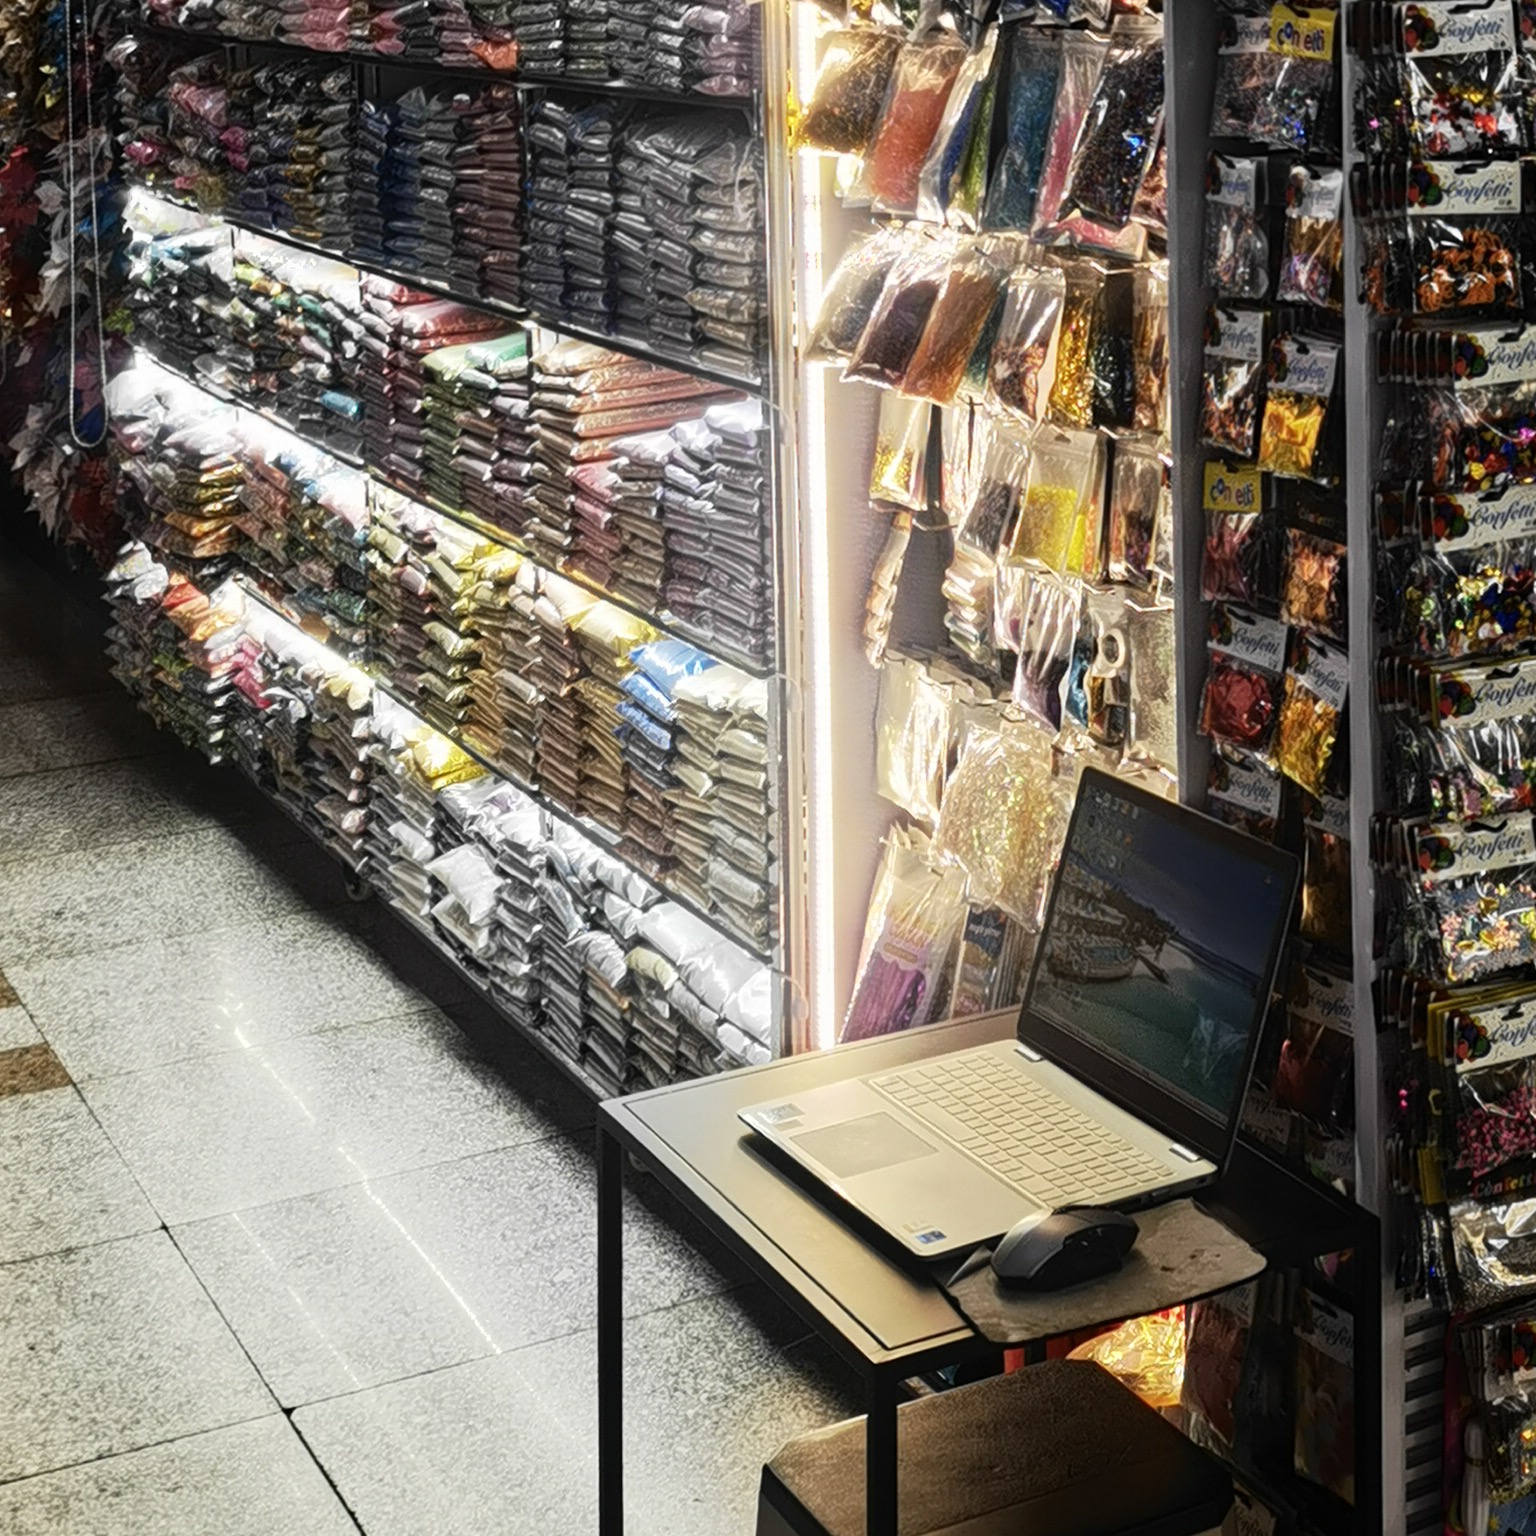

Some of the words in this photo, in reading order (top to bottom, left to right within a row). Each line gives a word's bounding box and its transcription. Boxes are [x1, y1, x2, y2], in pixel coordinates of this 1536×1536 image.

[1438, 17, 1500, 48] Confetti
[1446, 181, 1511, 205] Confetti
[1469, 503, 1536, 528] Confetti
[1234, 629, 1279, 657] Confetti
[1454, 836, 1524, 862] Confetti
